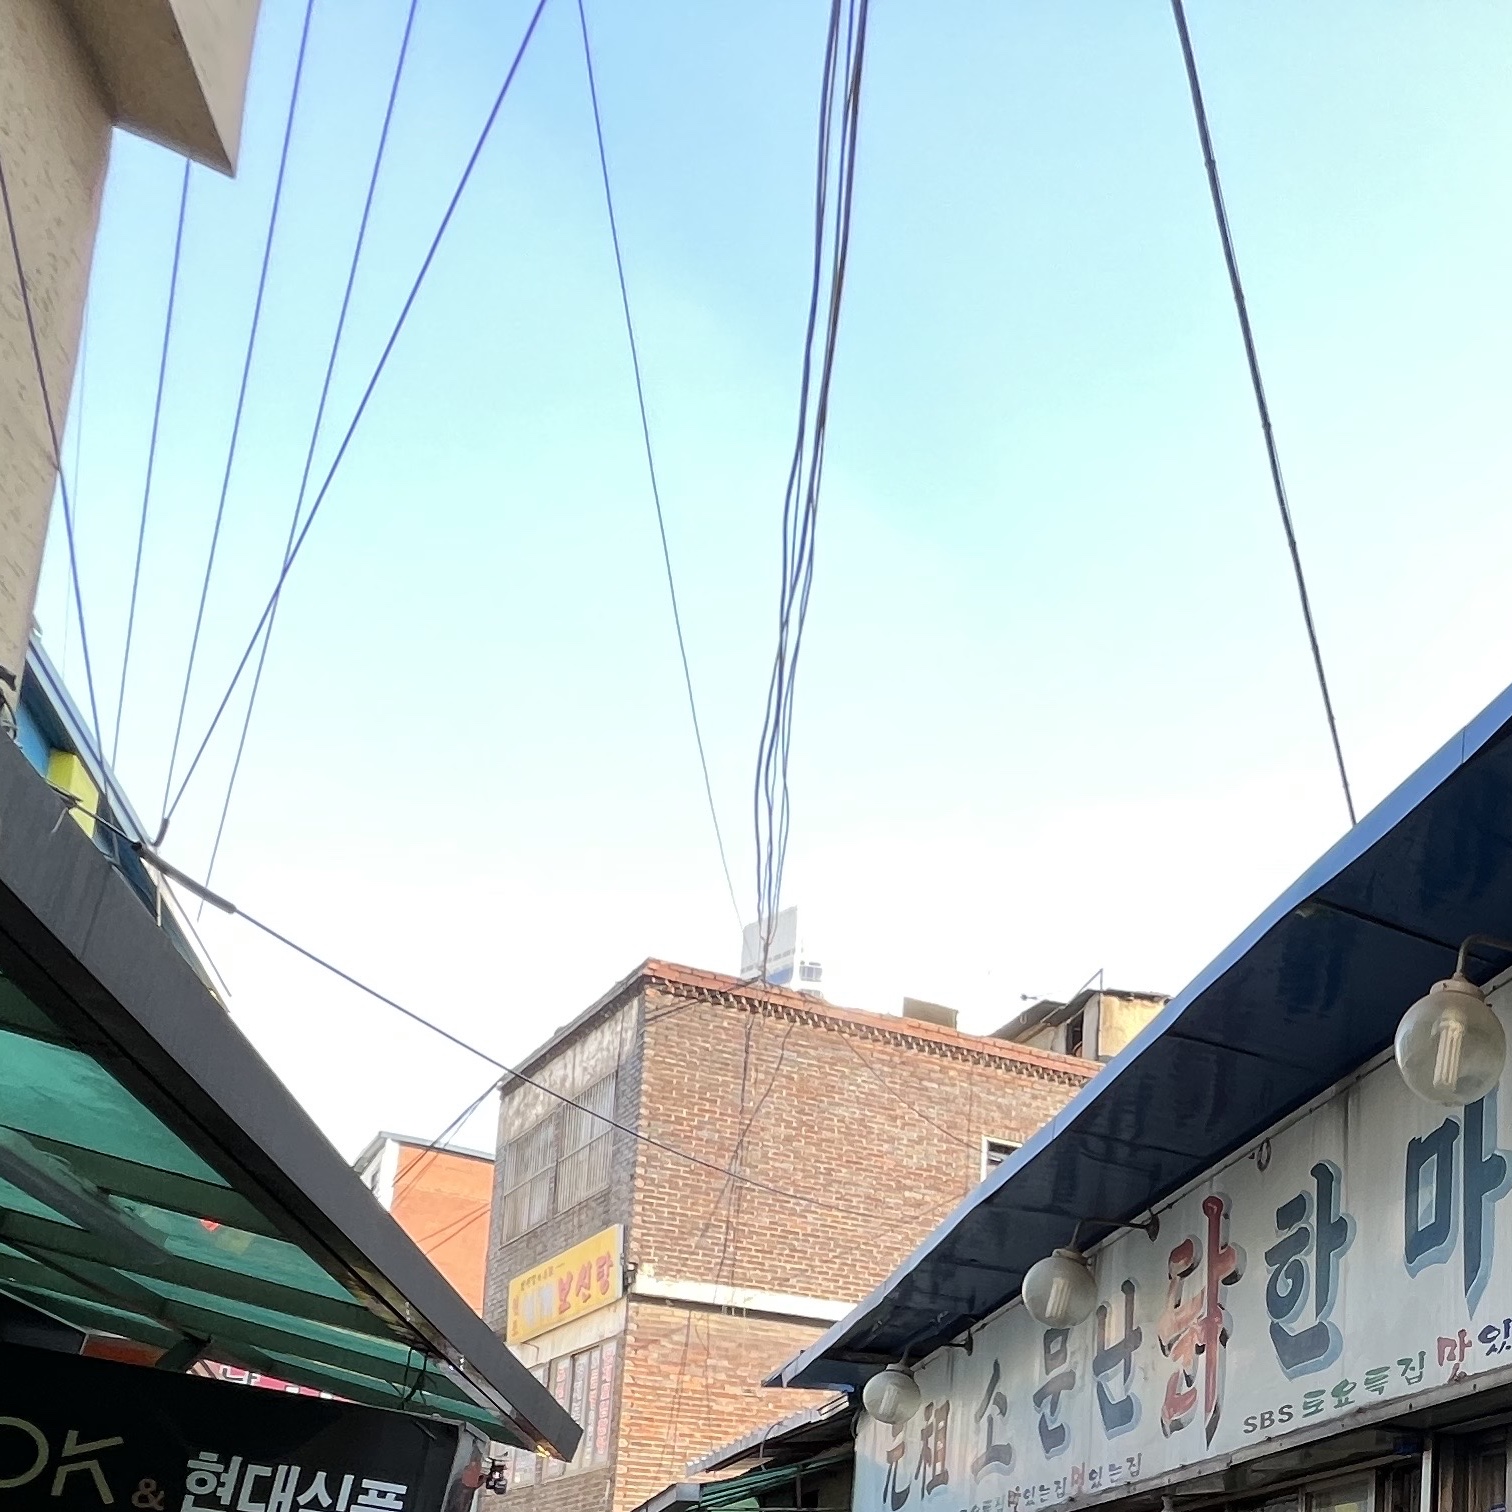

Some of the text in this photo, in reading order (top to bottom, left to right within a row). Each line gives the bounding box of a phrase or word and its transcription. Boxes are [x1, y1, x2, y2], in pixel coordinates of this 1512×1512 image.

[972, 1277, 1143, 1480] 소문난
[1243, 1403, 1295, 1436] SBS
[1301, 1350, 1426, 1418] 토요특집
[131, 1478, 165, 1511] &
